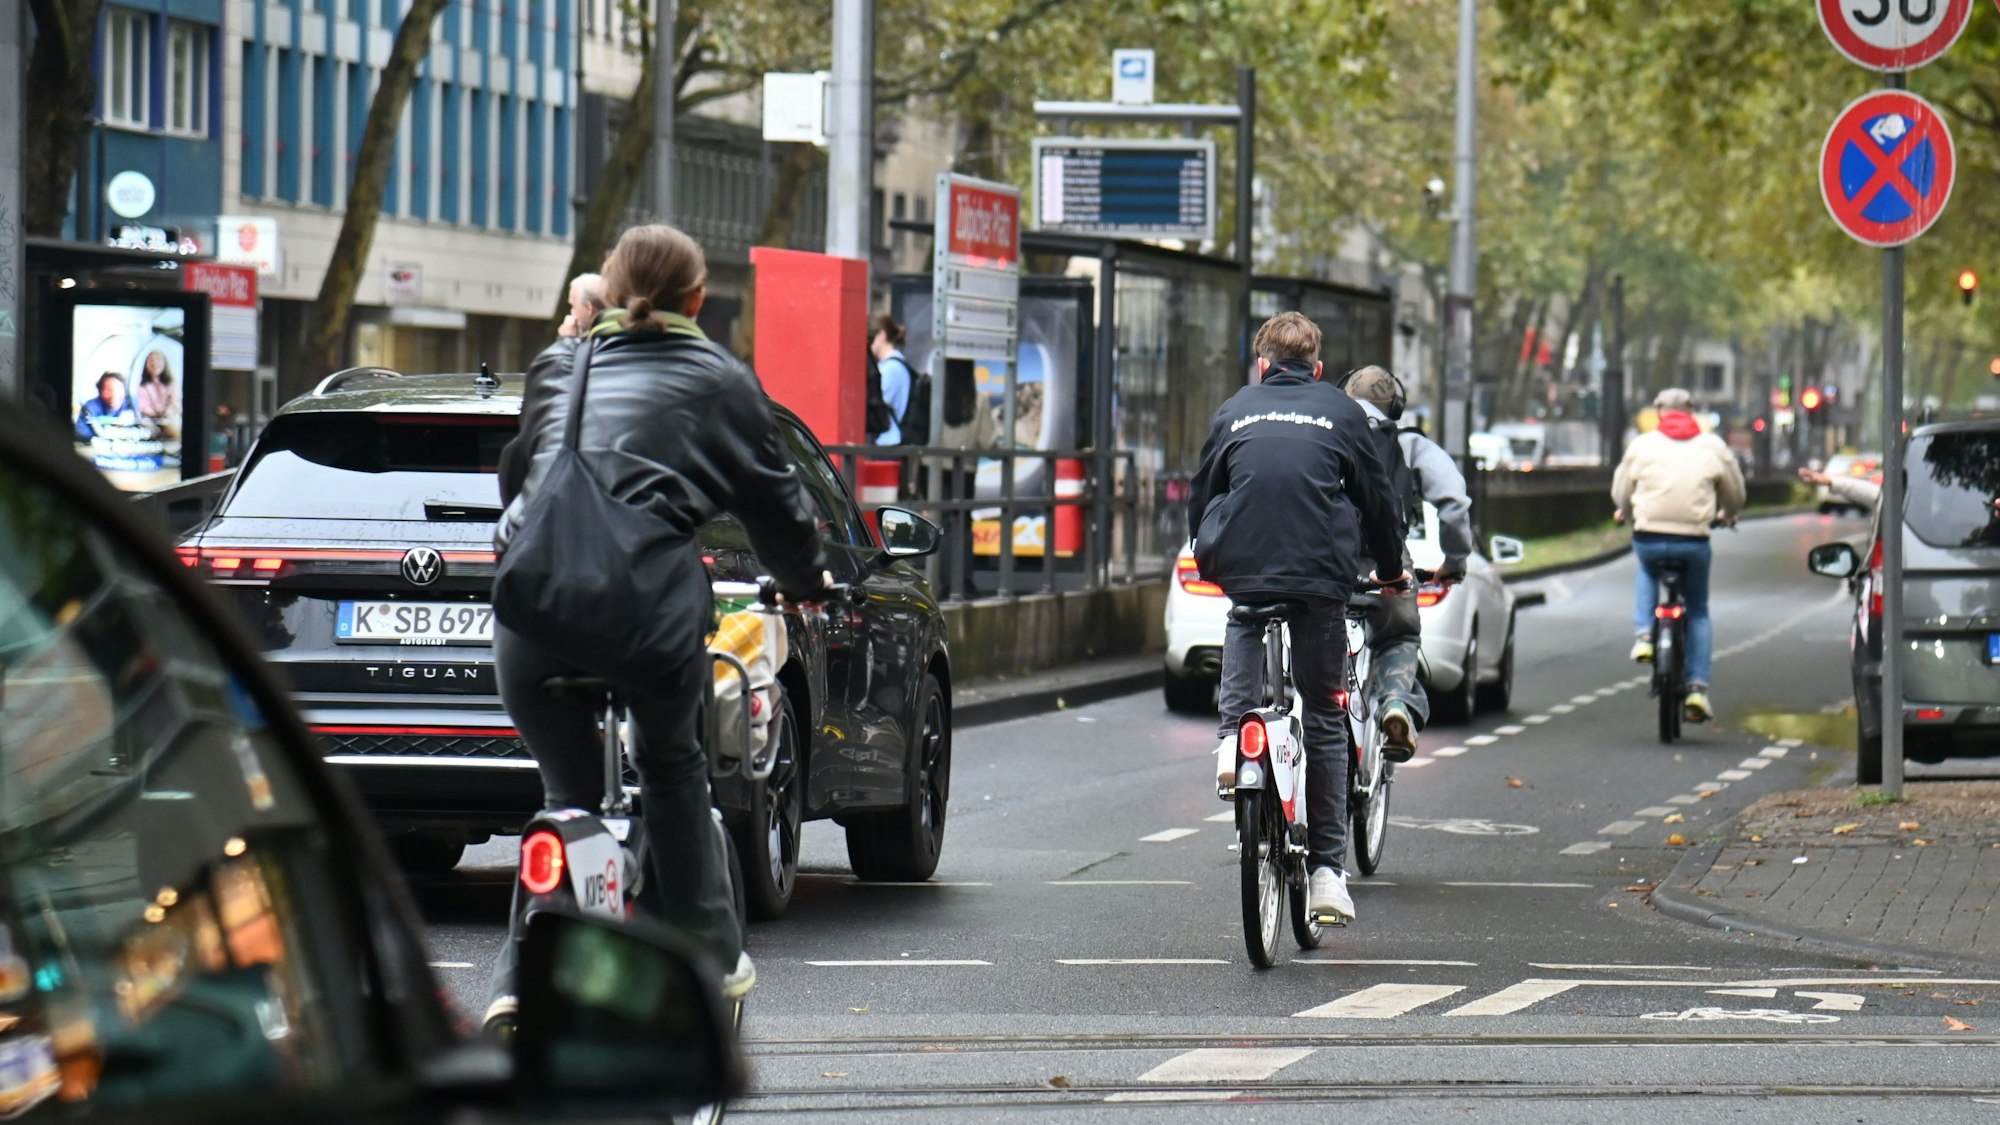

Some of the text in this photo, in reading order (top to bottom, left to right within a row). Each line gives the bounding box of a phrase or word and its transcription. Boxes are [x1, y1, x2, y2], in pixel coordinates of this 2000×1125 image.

[356, 606, 375, 633] K
[394, 606, 431, 634] SB
[439, 607, 494, 634] 697
[400, 638, 447, 646] AUTOSTADT
[366, 667, 478, 679] TIGUAN
[584, 873, 606, 908] KVB
